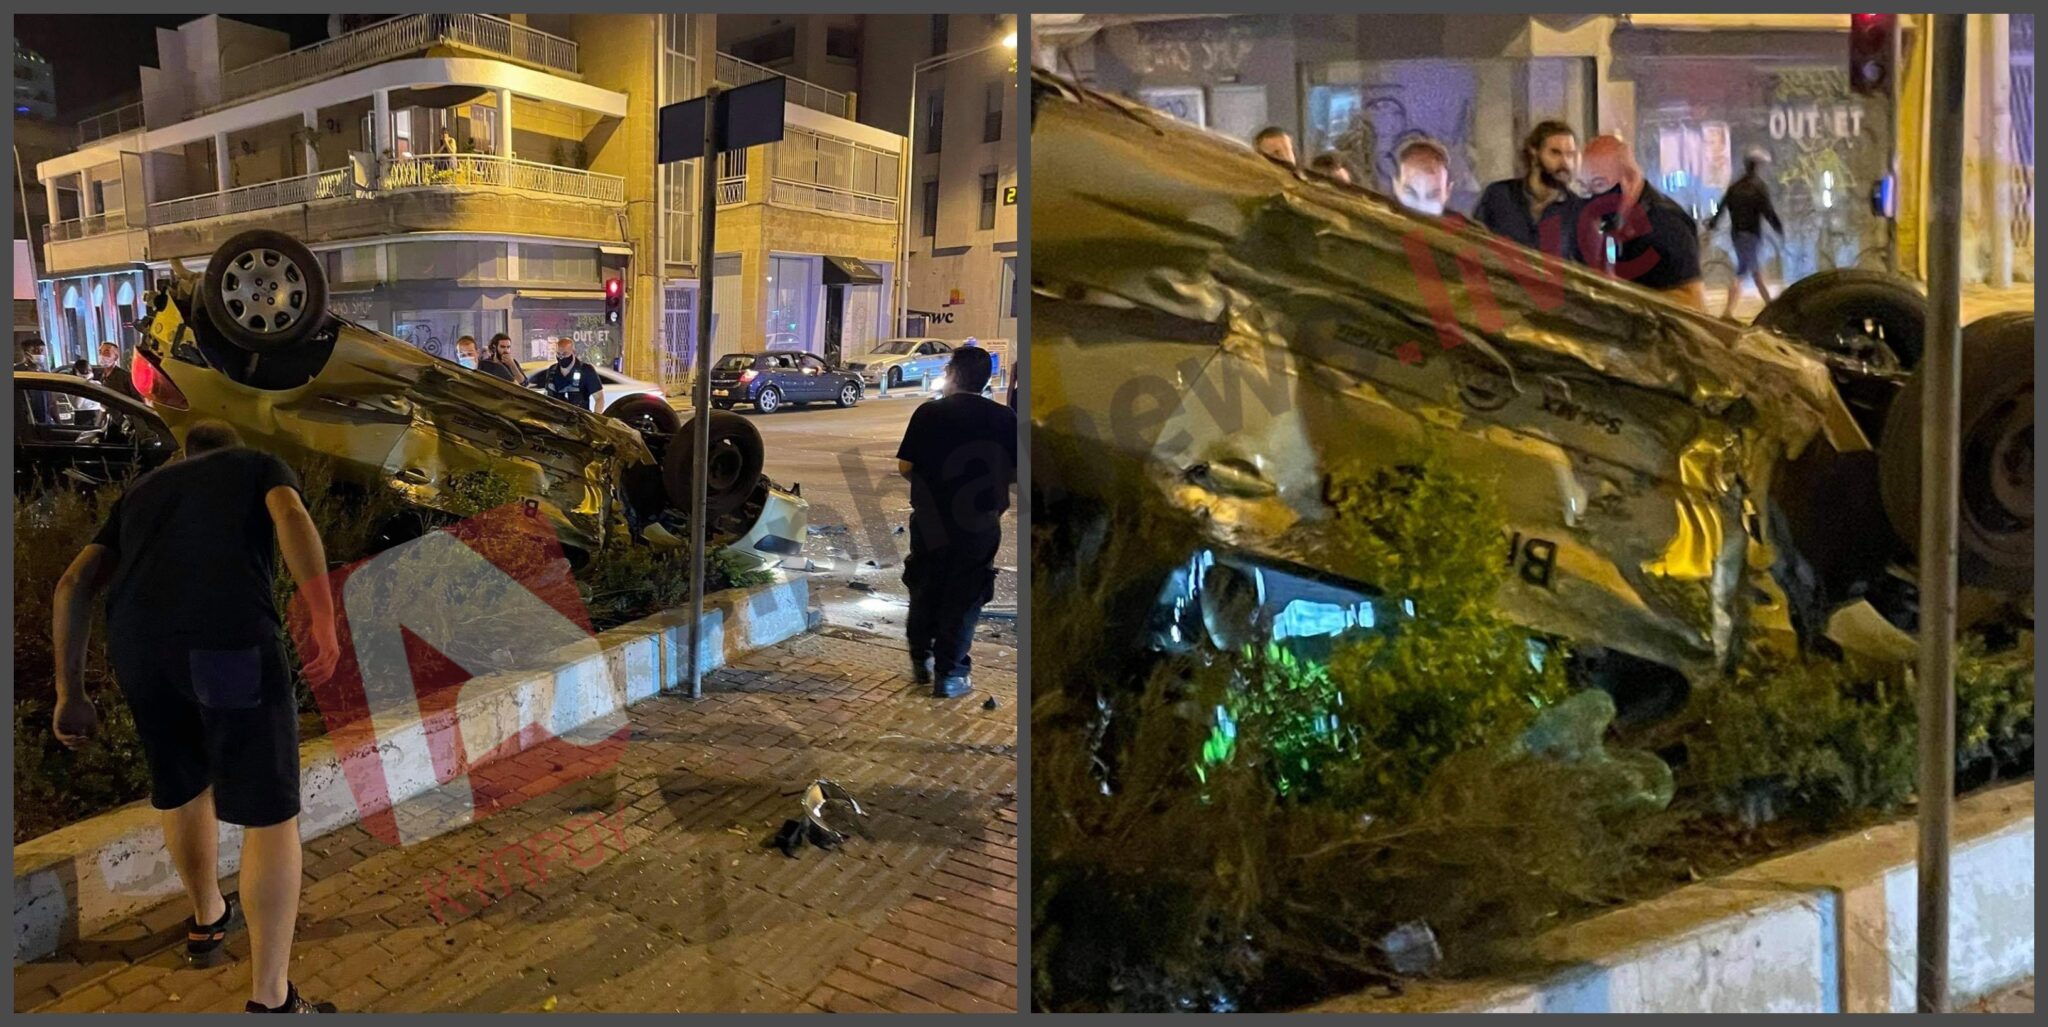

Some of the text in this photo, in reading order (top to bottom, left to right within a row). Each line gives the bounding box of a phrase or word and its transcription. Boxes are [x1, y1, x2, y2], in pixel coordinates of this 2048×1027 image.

[1769, 103, 1865, 141] OUTET
[1006, 187, 1017, 203] 2
[573, 330, 610, 343] OUTET
